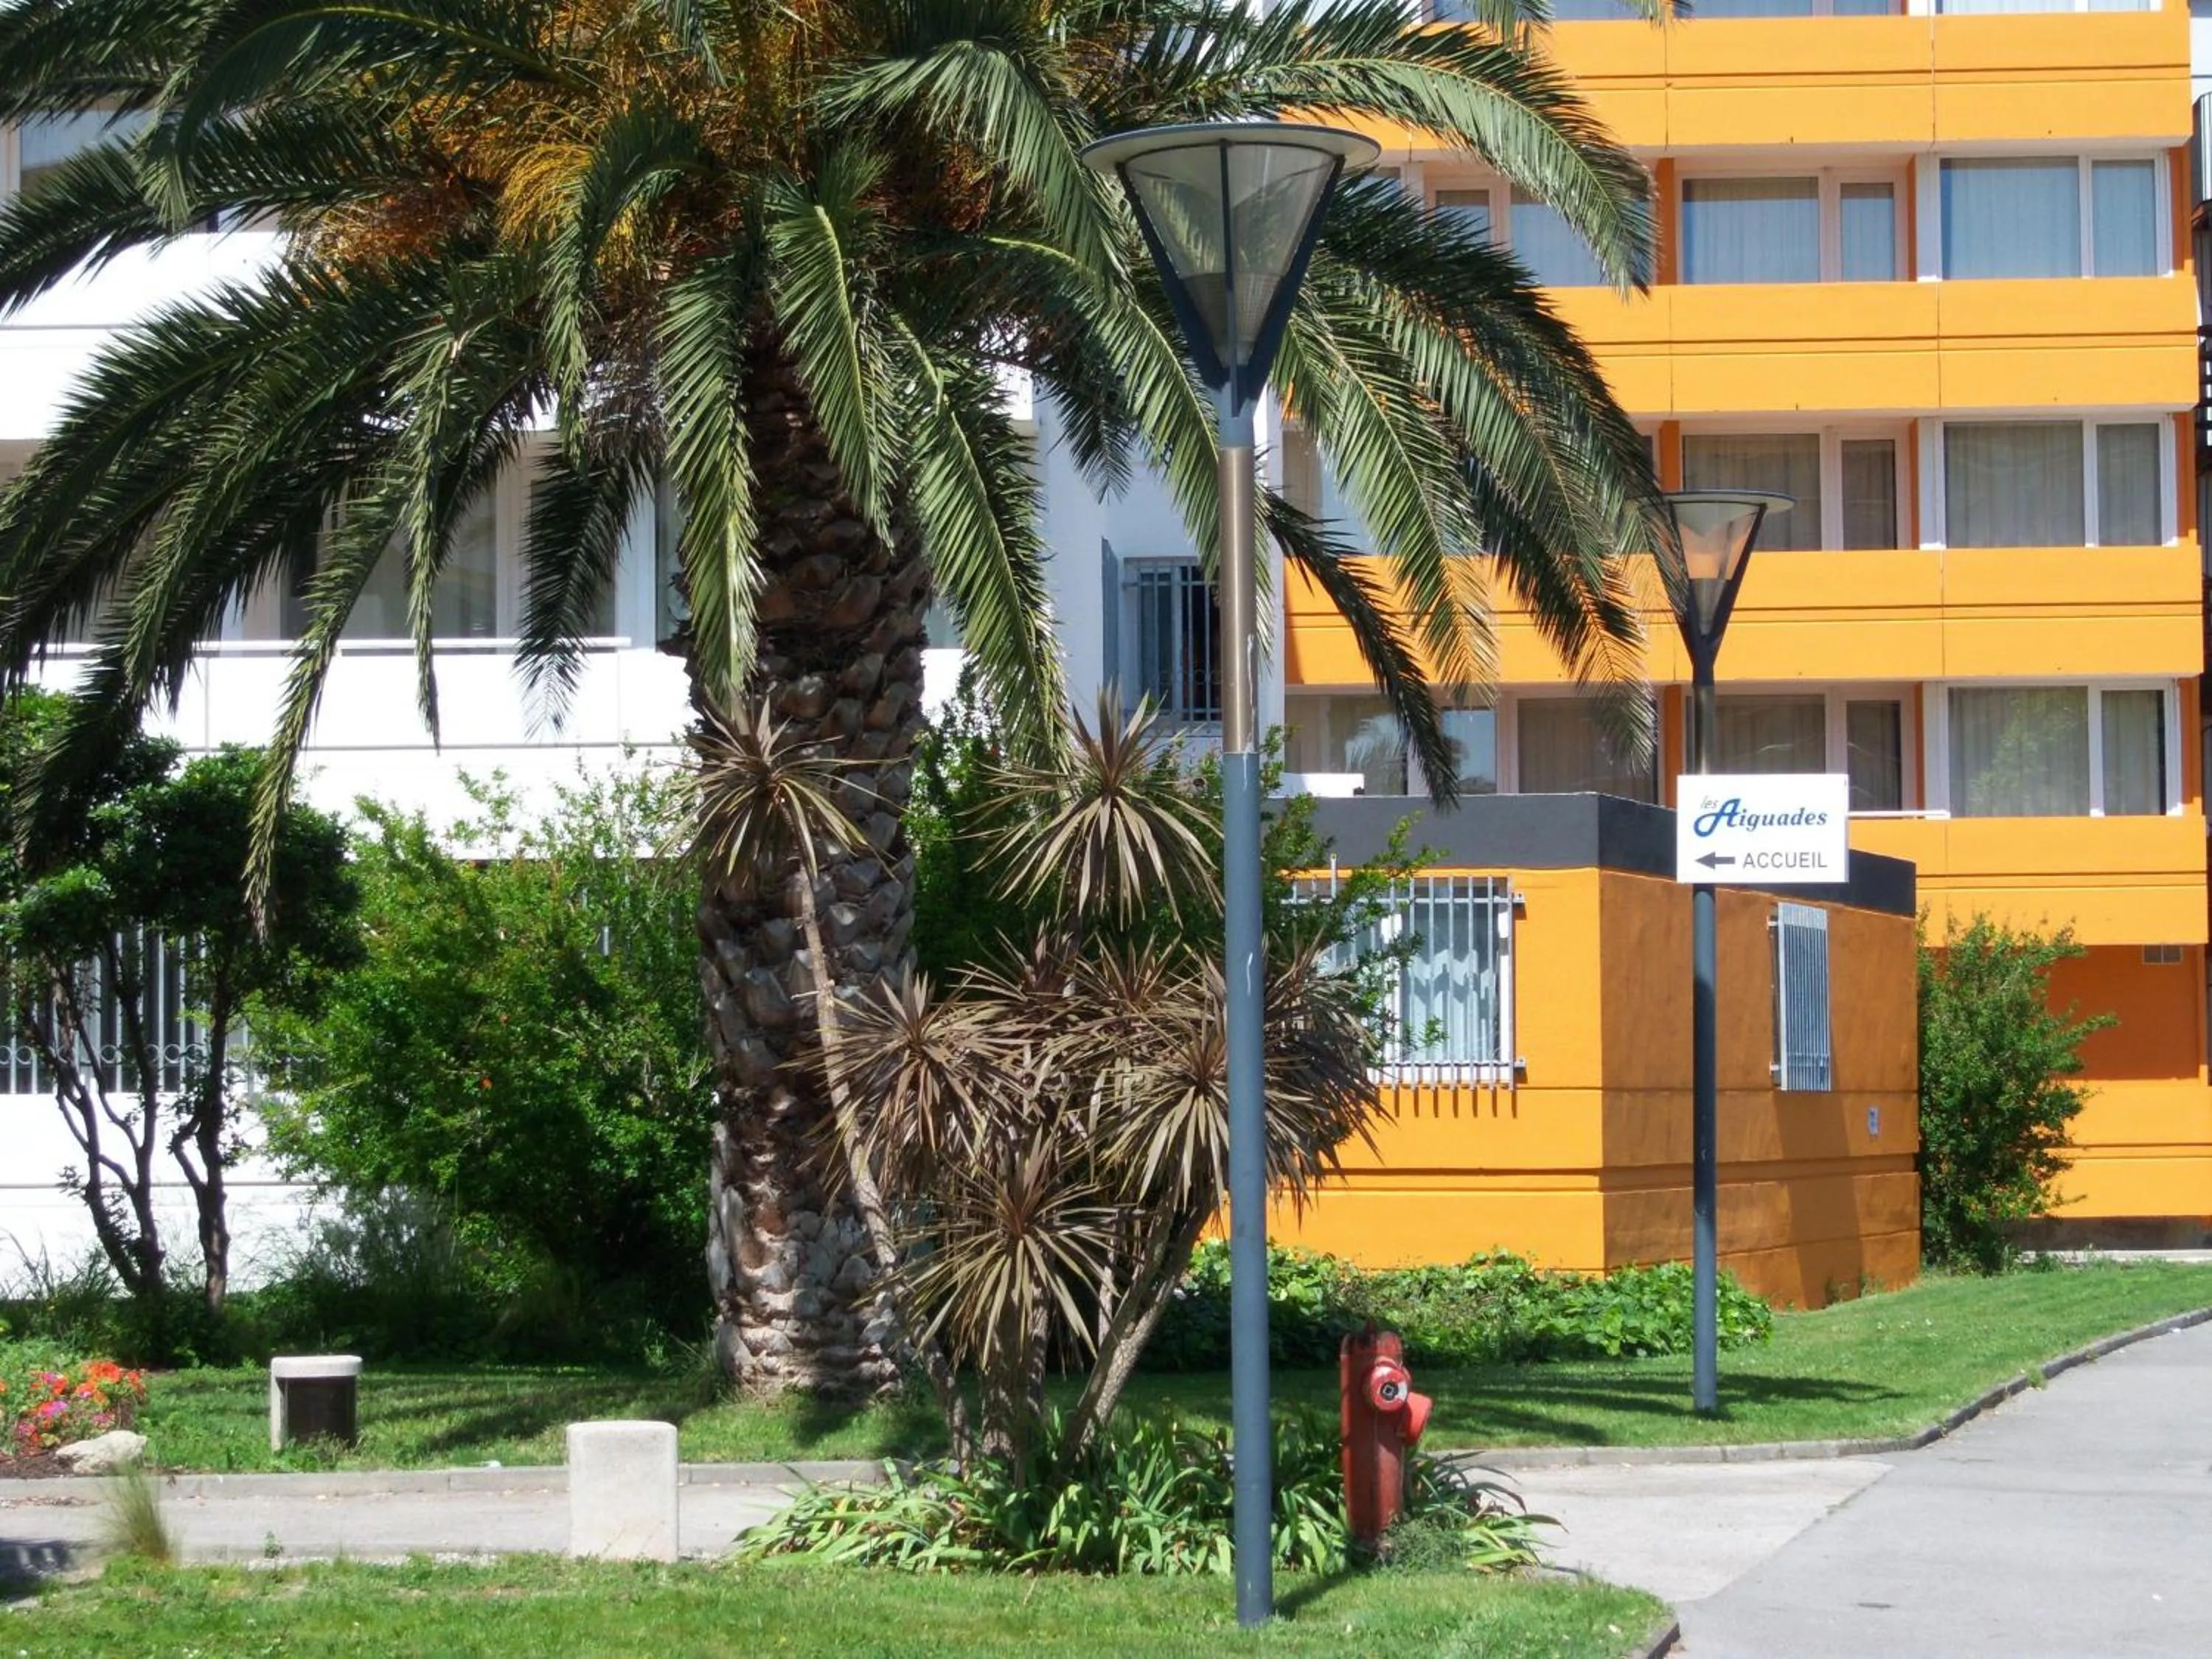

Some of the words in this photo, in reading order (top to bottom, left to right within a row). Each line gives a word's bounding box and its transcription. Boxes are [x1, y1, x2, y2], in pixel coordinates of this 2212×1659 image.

[1700, 796, 1719, 810] les
[1694, 799, 1828, 838] Aiguades
[1743, 852, 1828, 869] ACCUEIL
